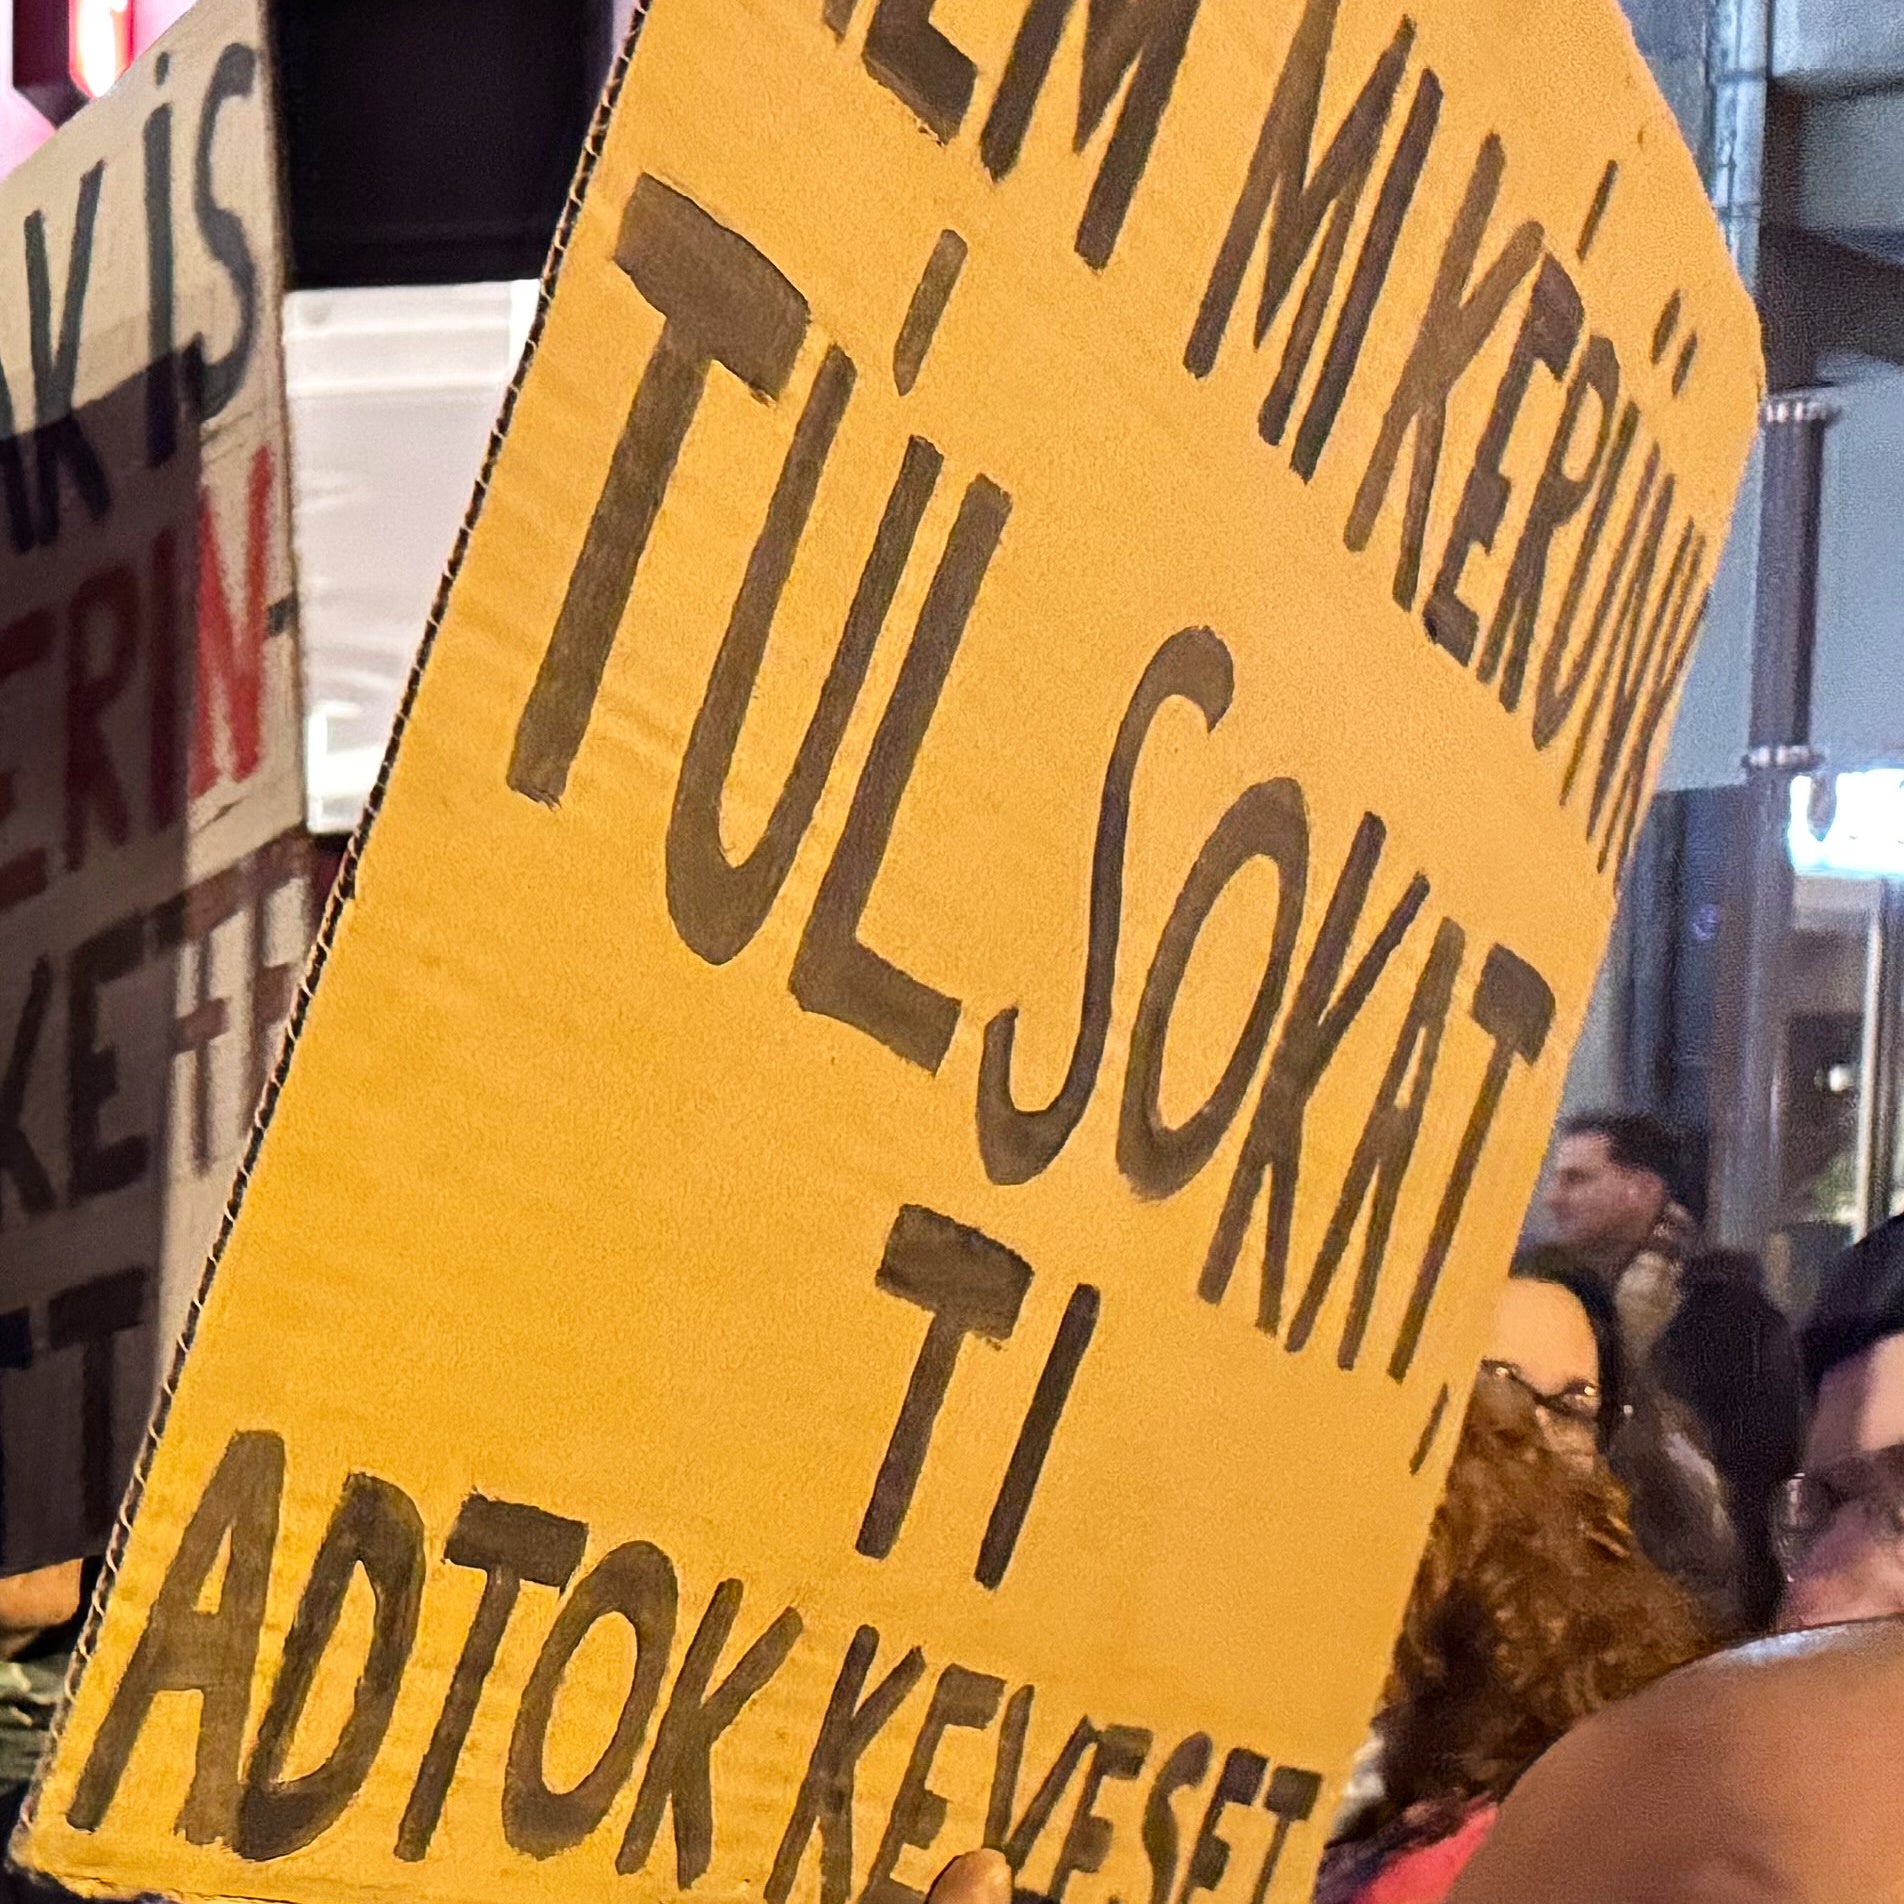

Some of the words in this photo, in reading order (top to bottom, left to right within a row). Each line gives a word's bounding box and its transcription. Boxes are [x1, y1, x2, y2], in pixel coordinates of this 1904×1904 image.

[1184, 0, 1443, 484] MI
[506, 172, 1012, 1075] TÚL
[856, 1204, 1099, 1590] TI
[65, 1430, 803, 1889] ADTOK
